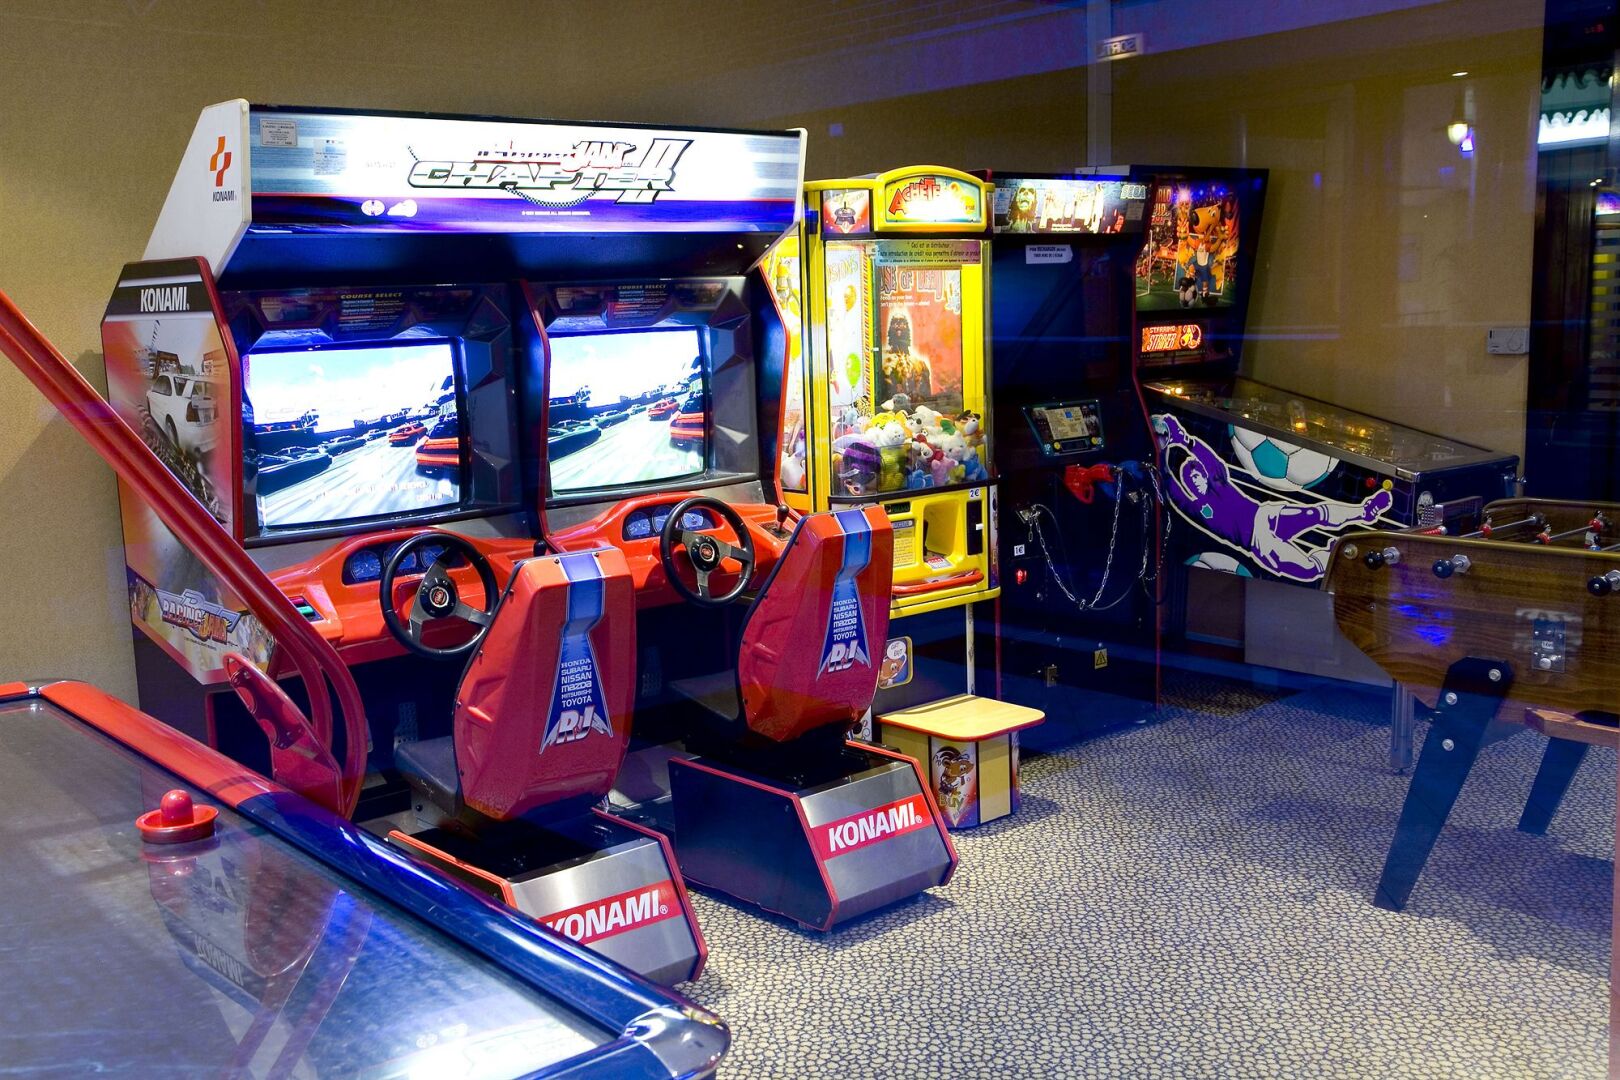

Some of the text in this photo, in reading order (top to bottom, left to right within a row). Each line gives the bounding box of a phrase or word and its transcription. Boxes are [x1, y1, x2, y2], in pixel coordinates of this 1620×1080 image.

[212, 190, 236, 203] KONAMI
[1120, 184, 1147, 200] SEGA
[140, 286, 188, 313] KONAMI
[833, 598, 857, 606] HONDA
[833, 604, 857, 612] SUBARU
[163, 599, 203, 624] RACING
[833, 610, 857, 620] NISSAN
[833, 630, 857, 642] TOYOTA
[561, 658, 592, 668] HONDA
[561, 664, 592, 676] SUBARU
[561, 672, 592, 684] NISSAN
[562, 688, 592, 700] MITSUBISHI
[562, 696, 592, 708] TOYOTA
[828, 801, 916, 852] KONAMI
[546, 889, 660, 945] KONAMI
